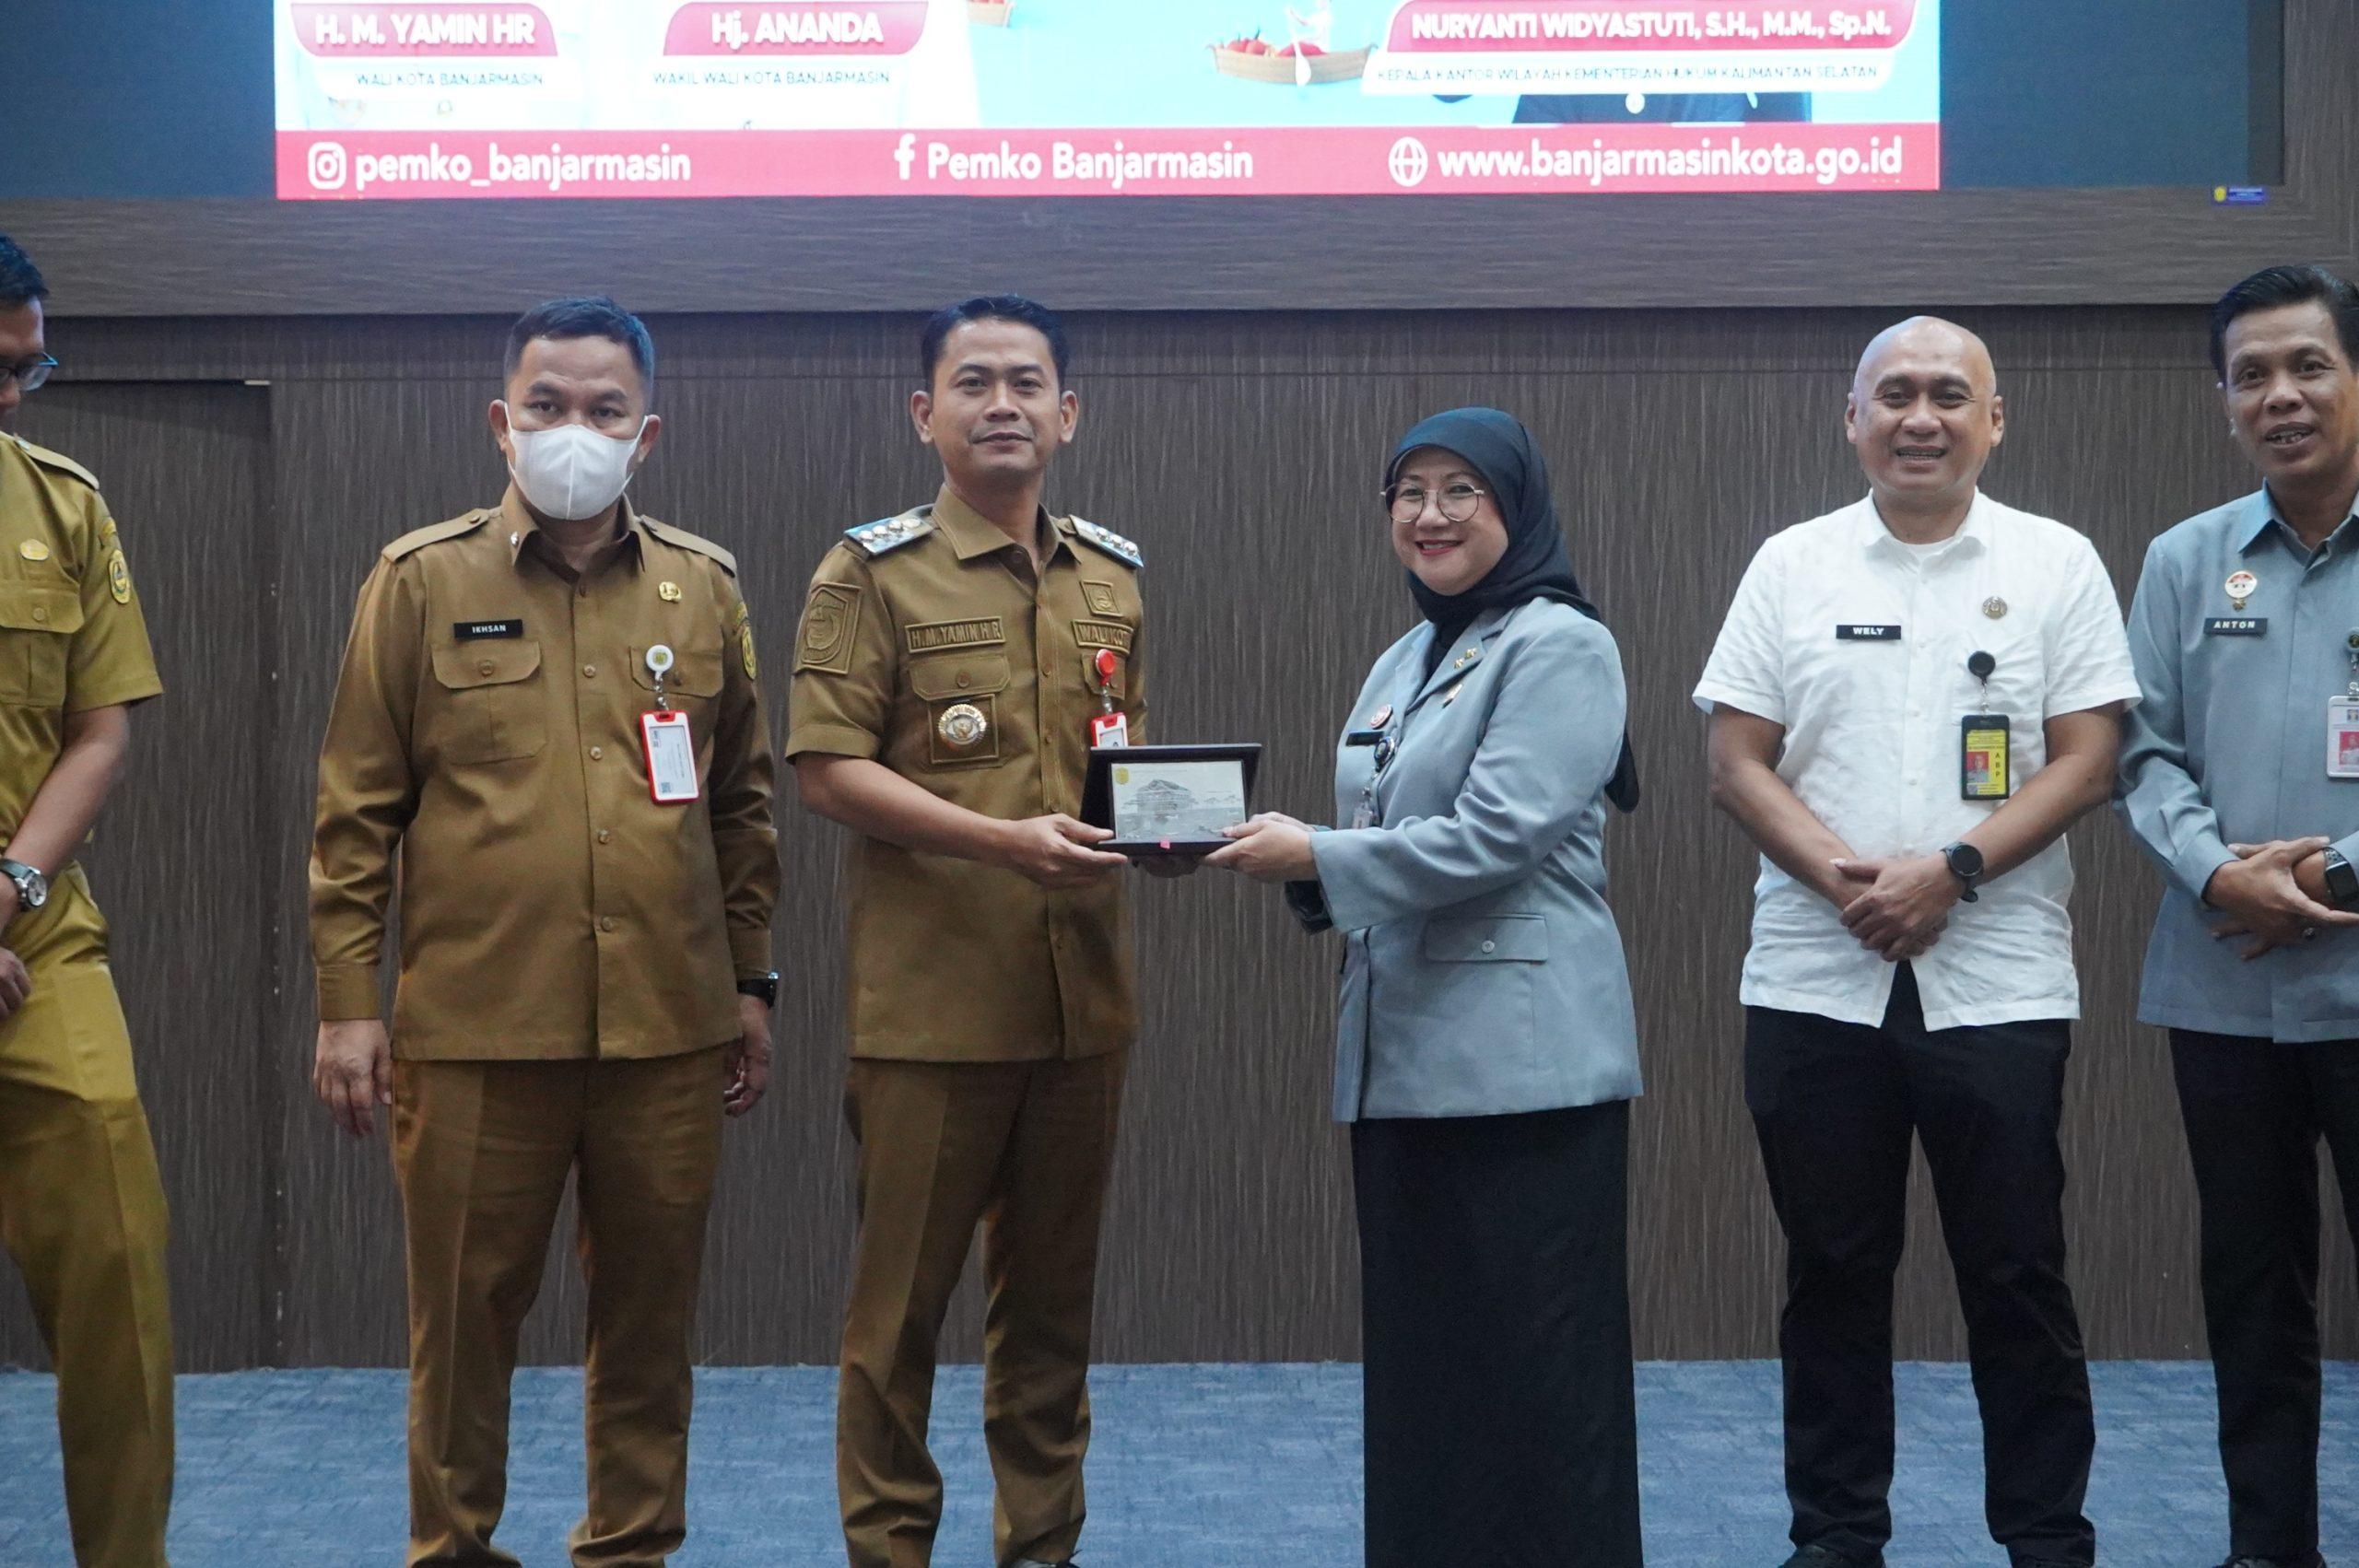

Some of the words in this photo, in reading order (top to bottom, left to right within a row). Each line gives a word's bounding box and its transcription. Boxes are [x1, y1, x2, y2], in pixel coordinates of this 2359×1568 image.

[390, 13, 487, 44] YAMIN
[493, 13, 535, 44] HR
[711, 9, 749, 50] Hj.
[754, 12, 885, 43] ANANDA
[1412, 13, 1538, 39] NURYANTI
[1541, 11, 1702, 40] WIDYASTUTI,
[1706, 11, 1758, 40] S.H.,
[1763, 10, 1825, 39] M.M.,
[1828, 9, 1892, 41] Sp.N.
[357, 73, 392, 85] WALI
[397, 73, 435, 85] KOTA
[440, 73, 544, 85] BANJARMASIN
[653, 72, 698, 85] WAKIL
[704, 72, 739, 85] WALI
[745, 72, 781, 84] KOTA
[787, 72, 890, 84] BANJARMASIN
[1379, 69, 1431, 81] KEPALA
[1437, 69, 1493, 80] KANTOR
[1497, 68, 1560, 80] WILAYAH
[1566, 67, 1661, 79] KEMENTERIAN
[1721, 66, 1811, 78] KALIMANTAN
[1816, 65, 1877, 77] SELATAN
[356, 143, 691, 191] pemko_banjarmasin
[928, 141, 1041, 180] Pemko
[1052, 140, 1253, 189] Banjarmasin
[1438, 135, 1903, 186] www.banjarmasinkota.go.id
[472, 625, 507, 634] IKHSAN
[1853, 626, 1884, 636] WELY
[2213, 620, 2256, 629] ANTON
